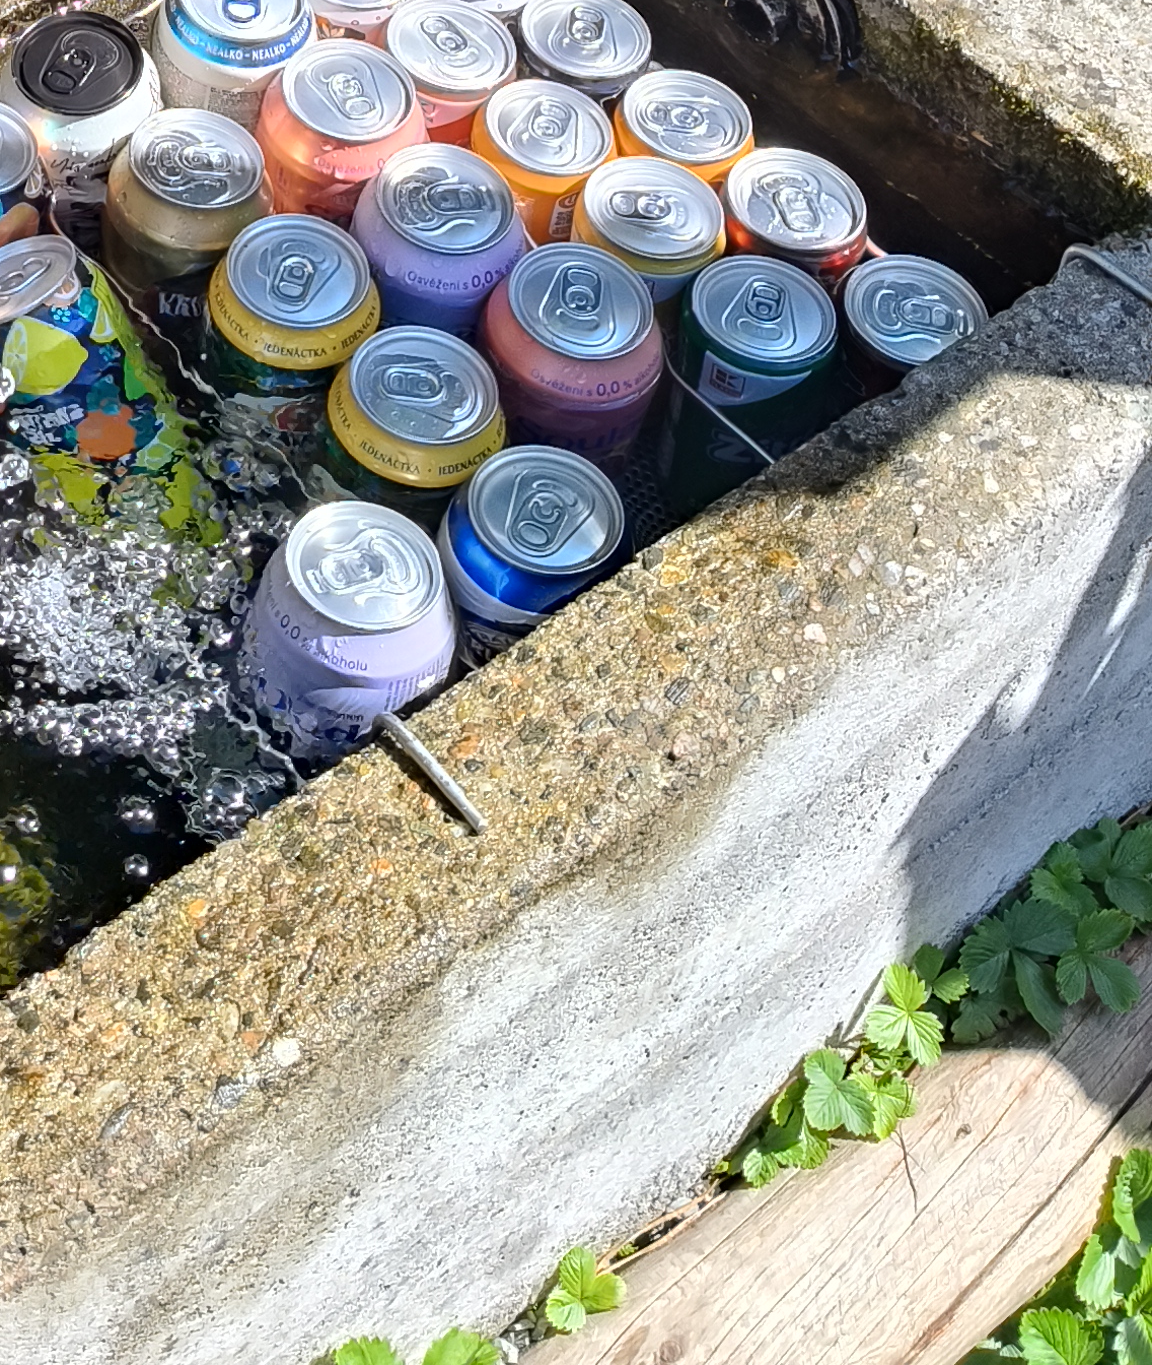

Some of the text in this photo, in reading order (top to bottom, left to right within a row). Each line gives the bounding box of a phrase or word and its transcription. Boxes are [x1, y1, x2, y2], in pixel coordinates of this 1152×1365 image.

[206, 42, 243, 60] NEALKO
[252, 43, 286, 61] NEALKO
[462, 281, 469, 290] s
[471, 270, 494, 289] 0,0
[586, 389, 593, 397] s
[596, 380, 620, 398] 0,0
[622, 380, 633, 390] %
[280, 614, 301, 640] 0,0
